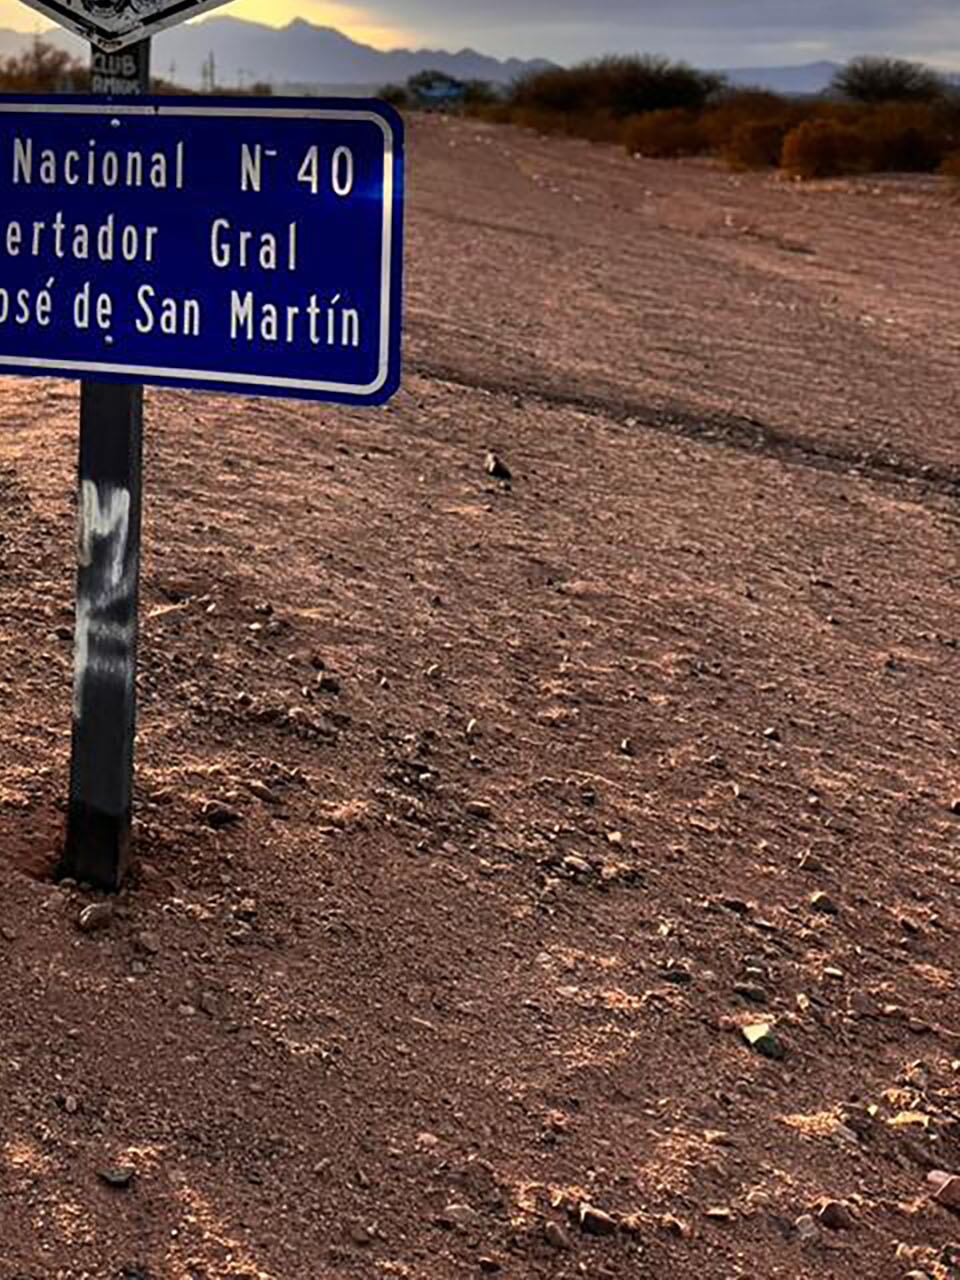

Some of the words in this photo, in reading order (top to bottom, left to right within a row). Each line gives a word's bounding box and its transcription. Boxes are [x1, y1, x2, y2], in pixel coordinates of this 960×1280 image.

[12, 136, 184, 189] Nacional
[297, 145, 355, 196] 40
[210, 218, 297, 271] Gral
[73, 281, 113, 329] de
[135, 284, 201, 337] San
[230, 290, 360, 348] Martín
